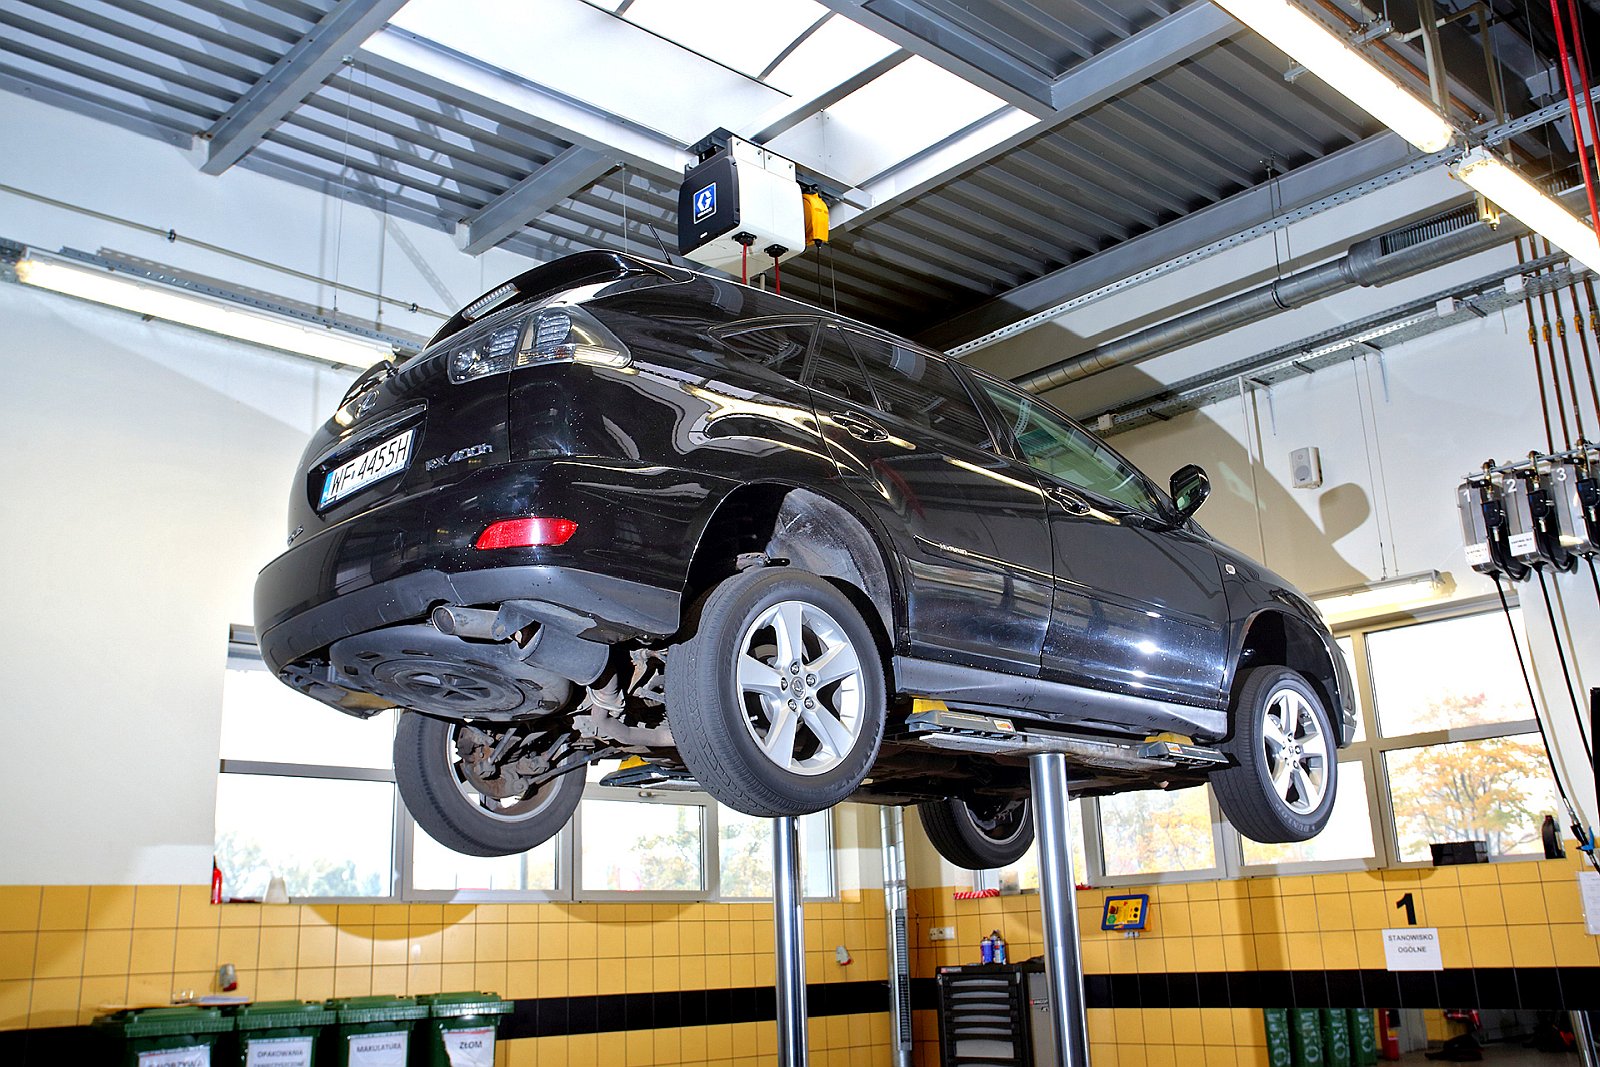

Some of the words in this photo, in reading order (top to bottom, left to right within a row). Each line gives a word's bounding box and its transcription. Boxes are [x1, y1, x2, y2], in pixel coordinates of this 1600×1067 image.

[331, 462, 355, 496] WF
[358, 434, 409, 480] 4455H
[1556, 467, 1567, 481] 3
[1506, 478, 1517, 493] 2
[1463, 489, 1472, 503] 1
[1396, 893, 1417, 925] 1
[1388, 934, 1434, 942] STANOWISKO
[356, 1042, 402, 1053] MAKULATURA
